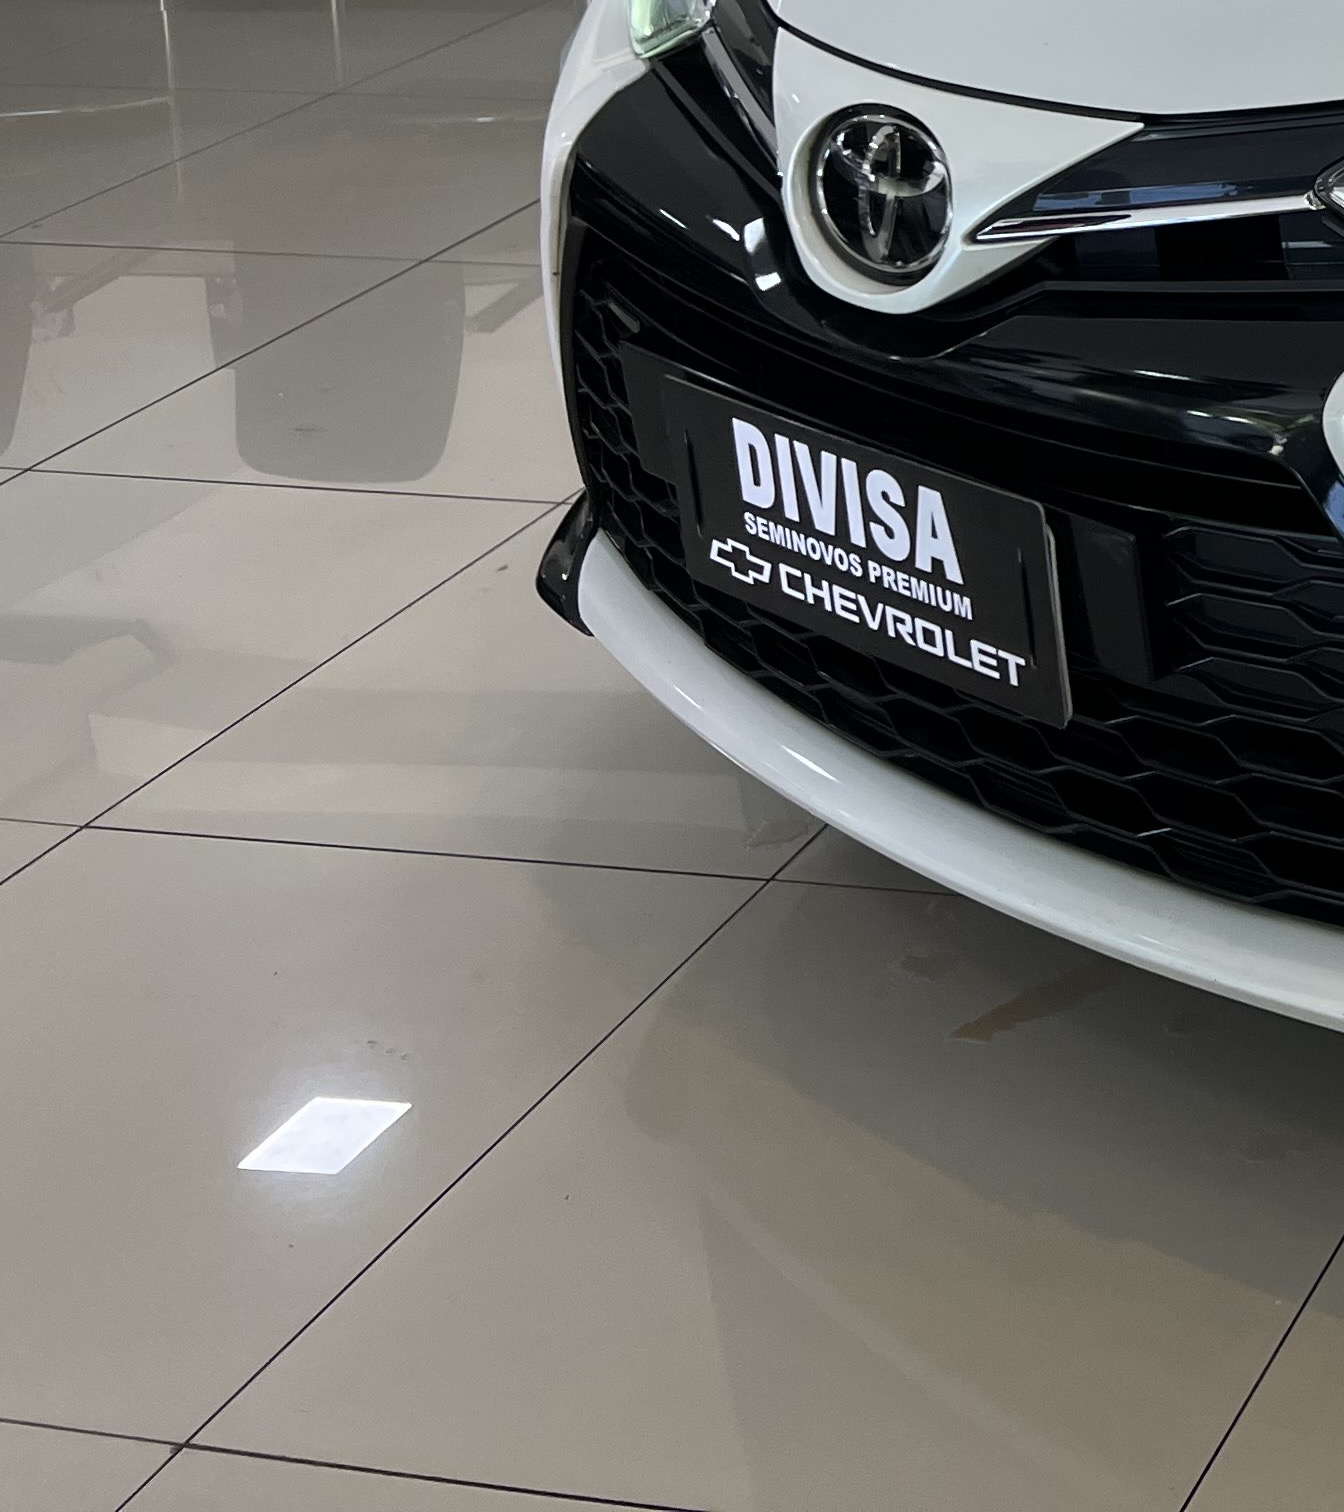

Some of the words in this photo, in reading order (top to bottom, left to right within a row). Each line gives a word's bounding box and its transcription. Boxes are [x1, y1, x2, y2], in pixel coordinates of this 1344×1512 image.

[732, 417, 964, 585] DIVISA
[744, 511, 863, 578] SEMINOVOS
[869, 559, 973, 621] PREMIUM
[779, 562, 1026, 687] CHEVROLET
